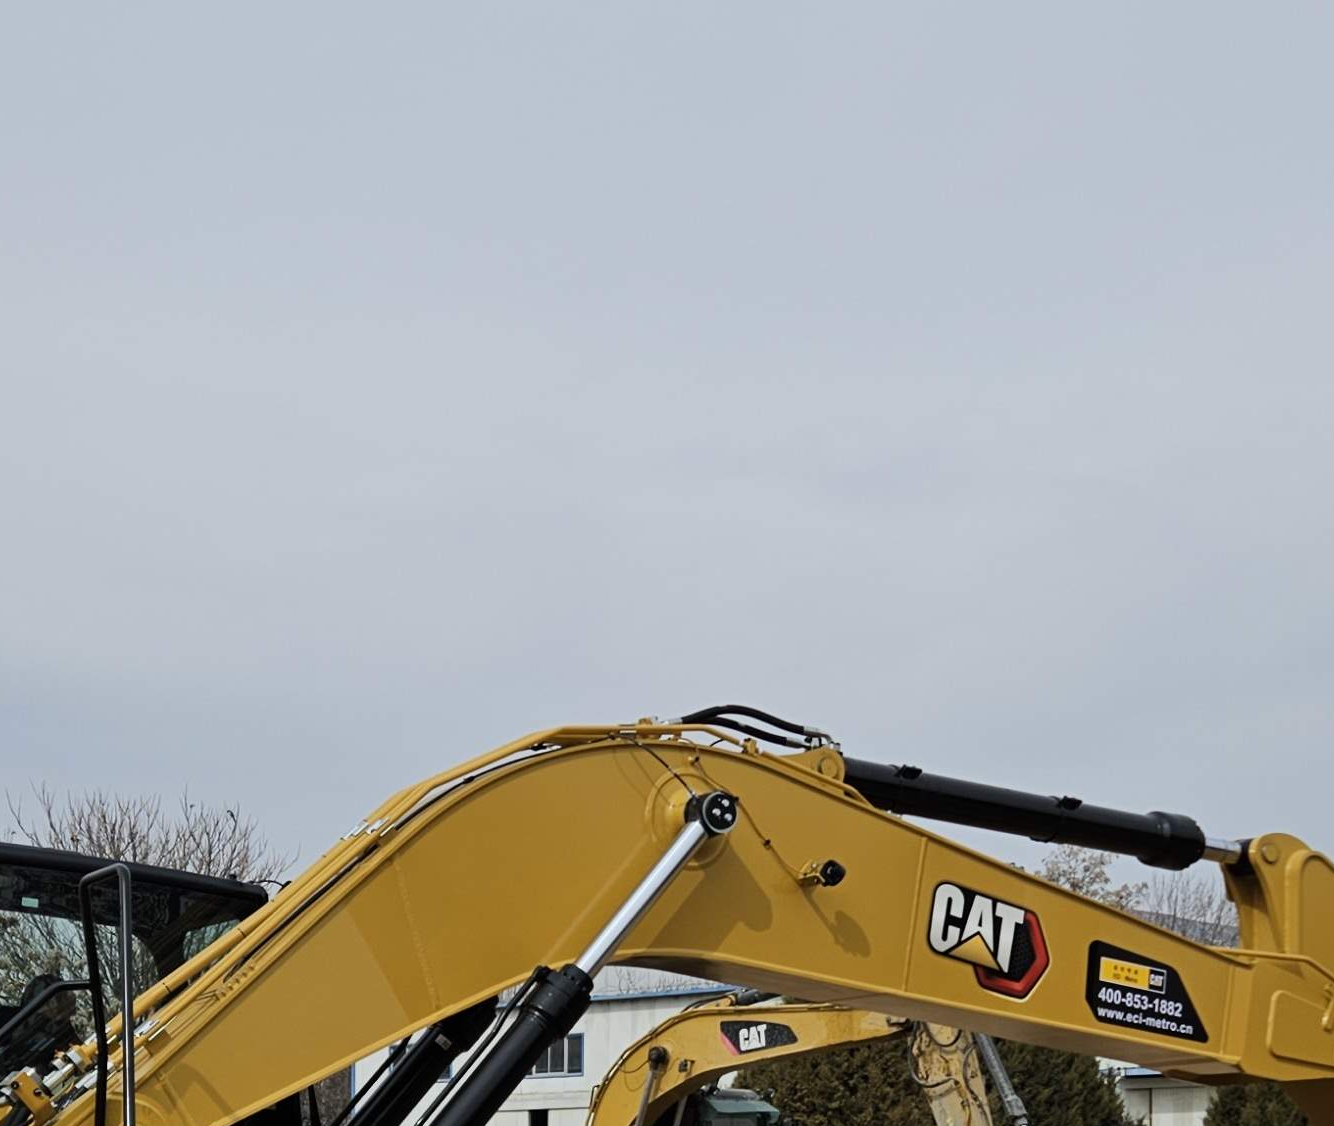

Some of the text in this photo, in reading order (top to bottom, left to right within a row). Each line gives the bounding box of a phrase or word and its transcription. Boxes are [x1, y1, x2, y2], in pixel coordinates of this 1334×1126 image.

[929, 883, 1026, 974] CAT
[1149, 974, 1164, 987] CAT
[1098, 987, 1183, 1018] 400-853-1882
[1097, 1006, 1194, 1035] www.eci-metro.cn
[739, 1023, 767, 1051] CAT
